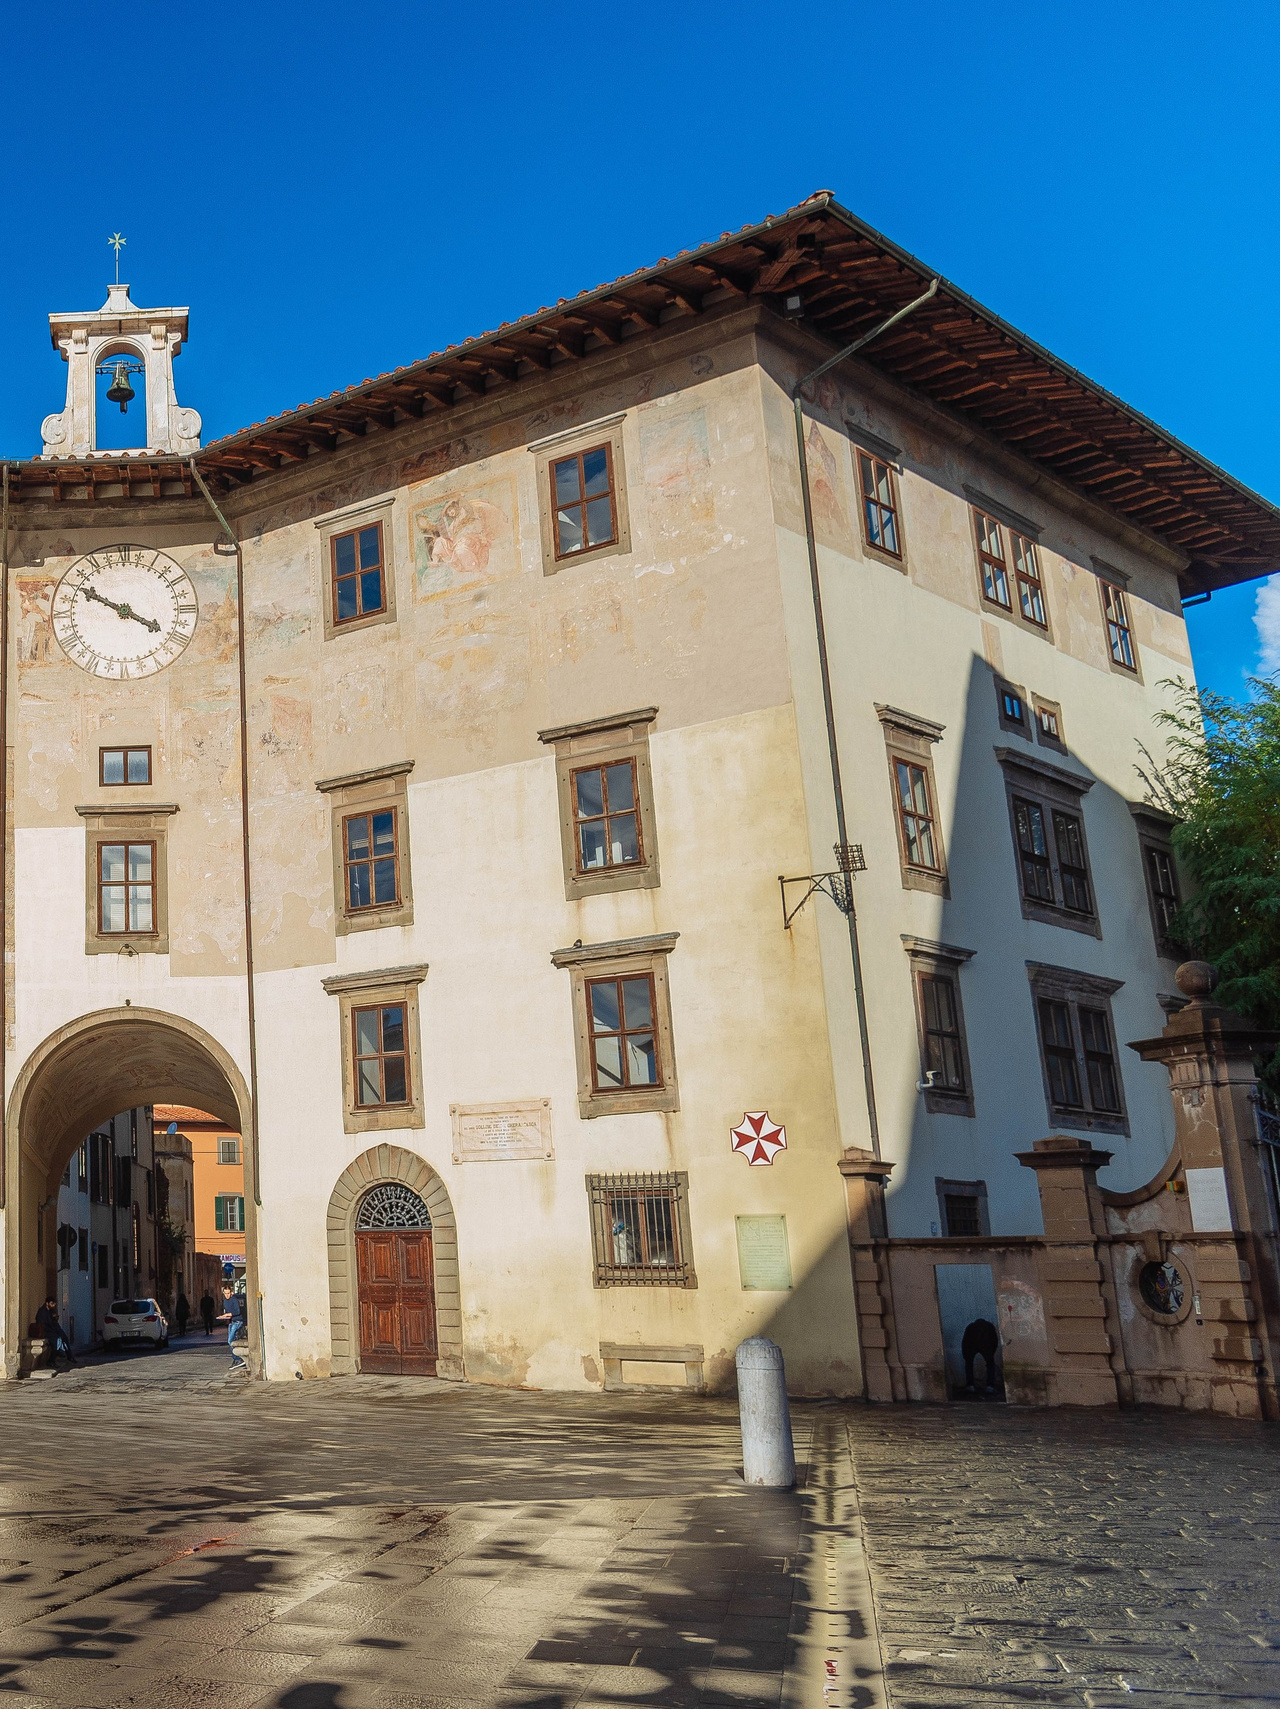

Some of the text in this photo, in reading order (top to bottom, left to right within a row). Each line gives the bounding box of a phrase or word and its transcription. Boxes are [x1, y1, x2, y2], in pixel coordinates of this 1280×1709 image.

[118, 546, 130, 561] XII
[86, 554, 101, 570] XI
[171, 574, 187, 586] II
[54, 610, 70, 619] IX
[180, 604, 196, 613] III
[60, 632, 78, 655] VIII
[170, 631, 190, 648] IIII
[85, 655, 99, 674] VII
[120, 663, 130, 679] VI
